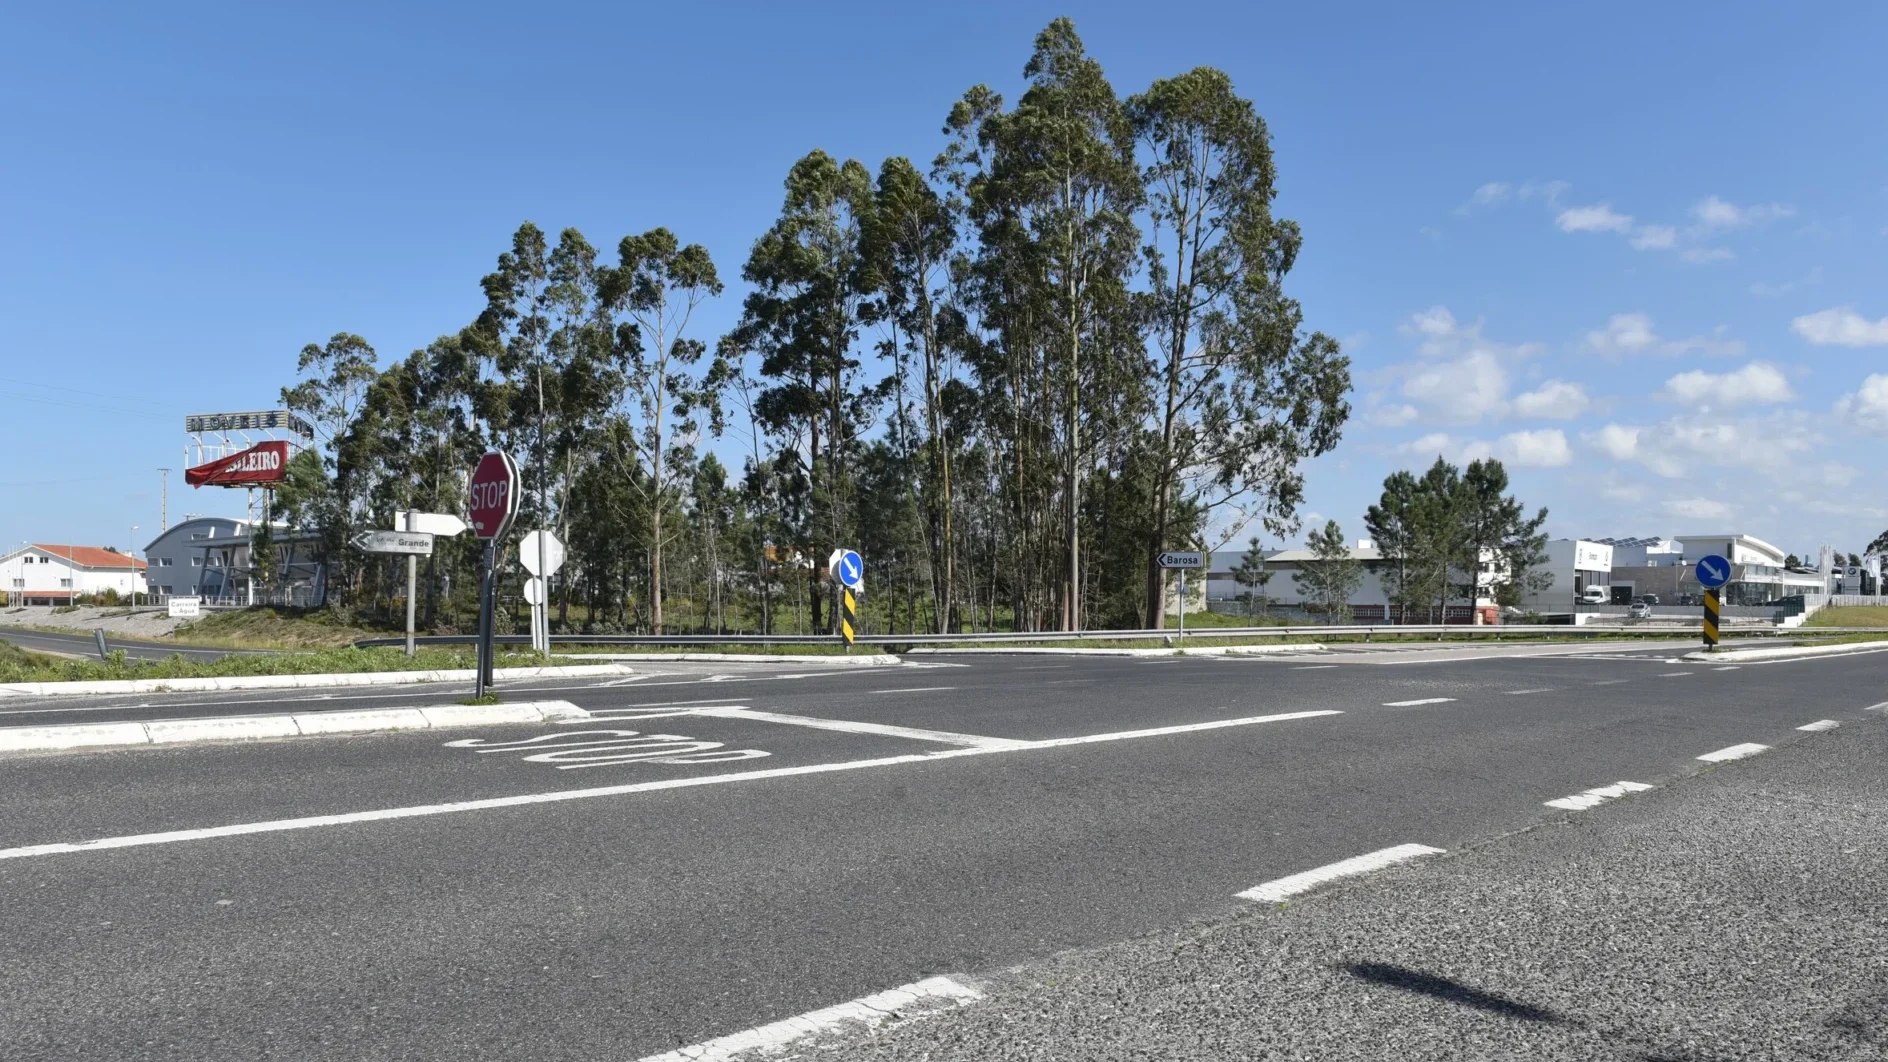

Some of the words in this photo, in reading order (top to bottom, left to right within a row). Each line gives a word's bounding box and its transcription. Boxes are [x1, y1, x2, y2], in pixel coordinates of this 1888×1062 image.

[471, 480, 507, 510] STOP
[398, 538, 429, 547] Grande
[1167, 555, 1198, 564] Barosa
